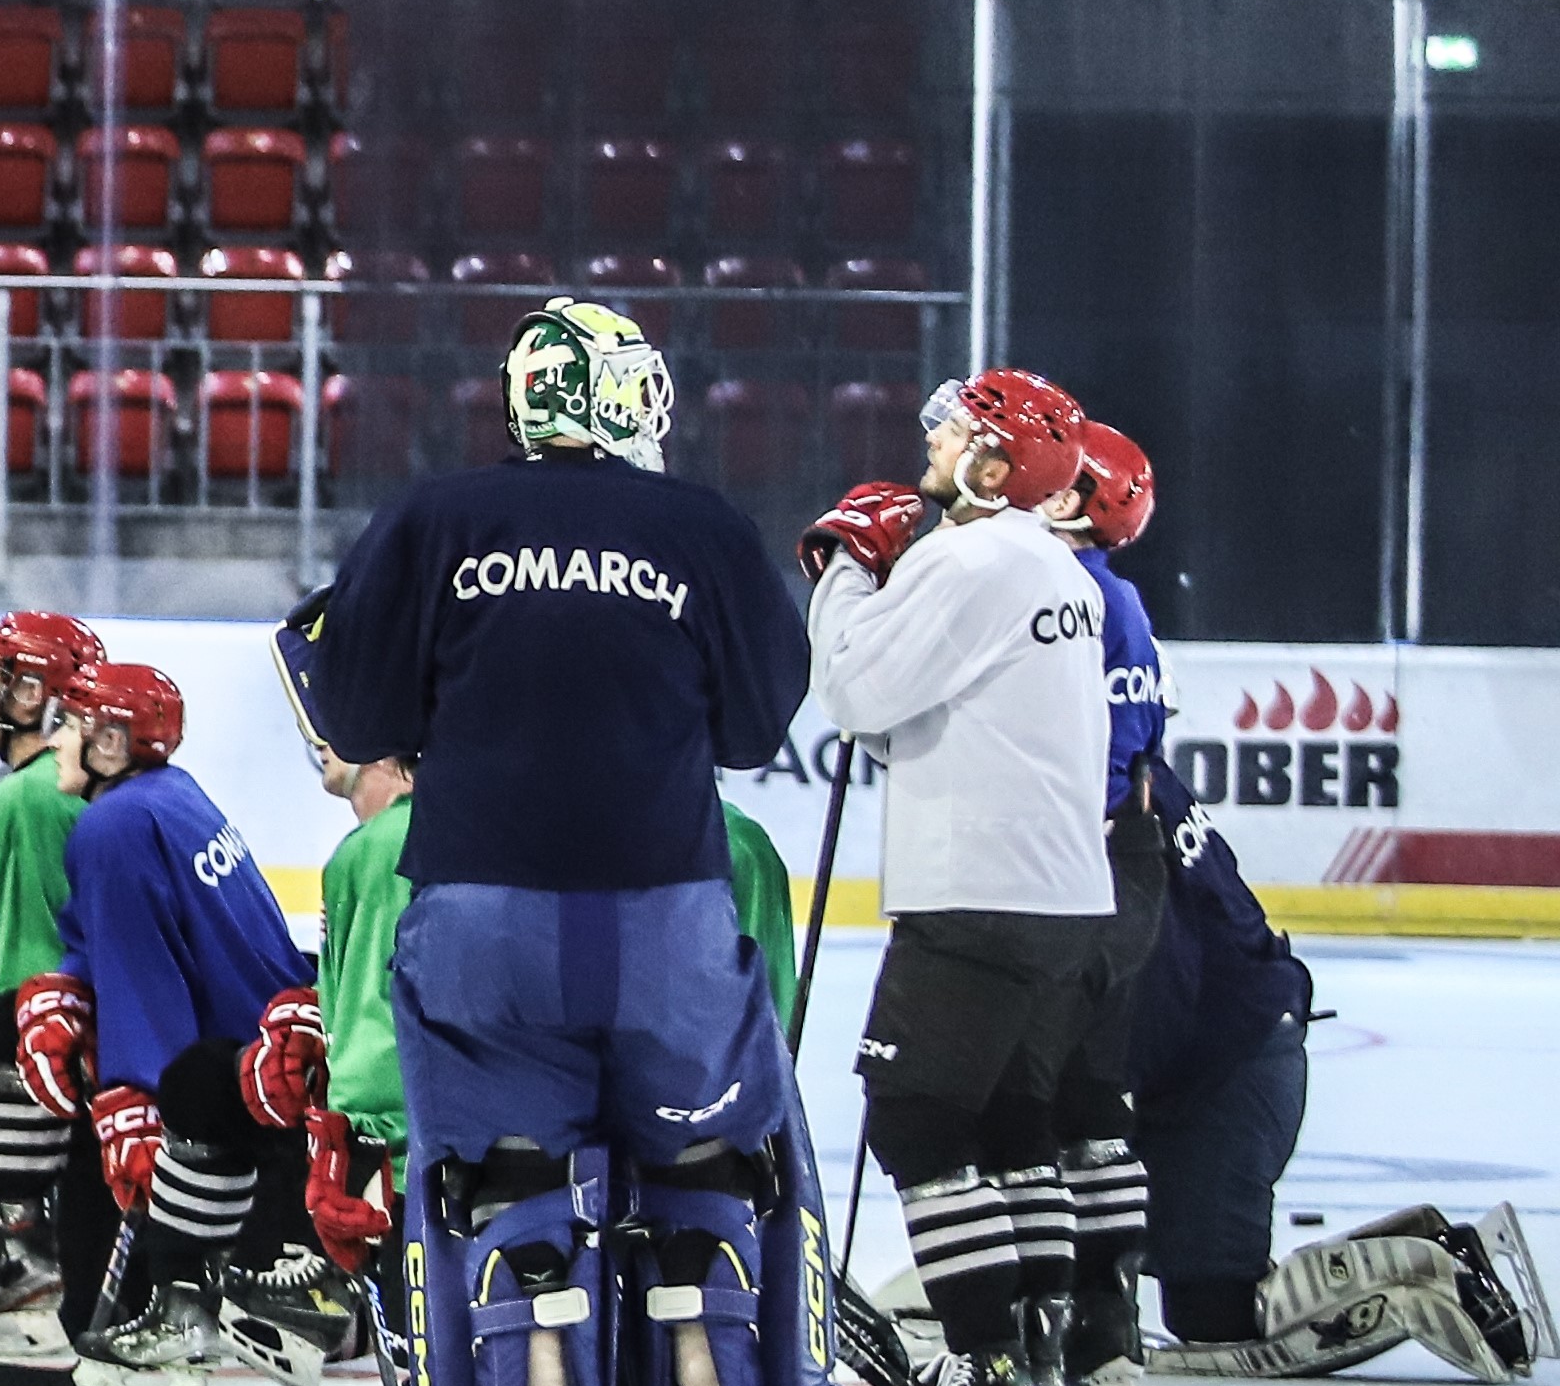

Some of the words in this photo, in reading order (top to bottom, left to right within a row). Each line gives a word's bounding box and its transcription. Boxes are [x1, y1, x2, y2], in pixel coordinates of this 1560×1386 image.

[453, 545, 689, 623] COMARCH
[654, 1081, 742, 1124] CCM
[801, 1205, 827, 1368] CCM
